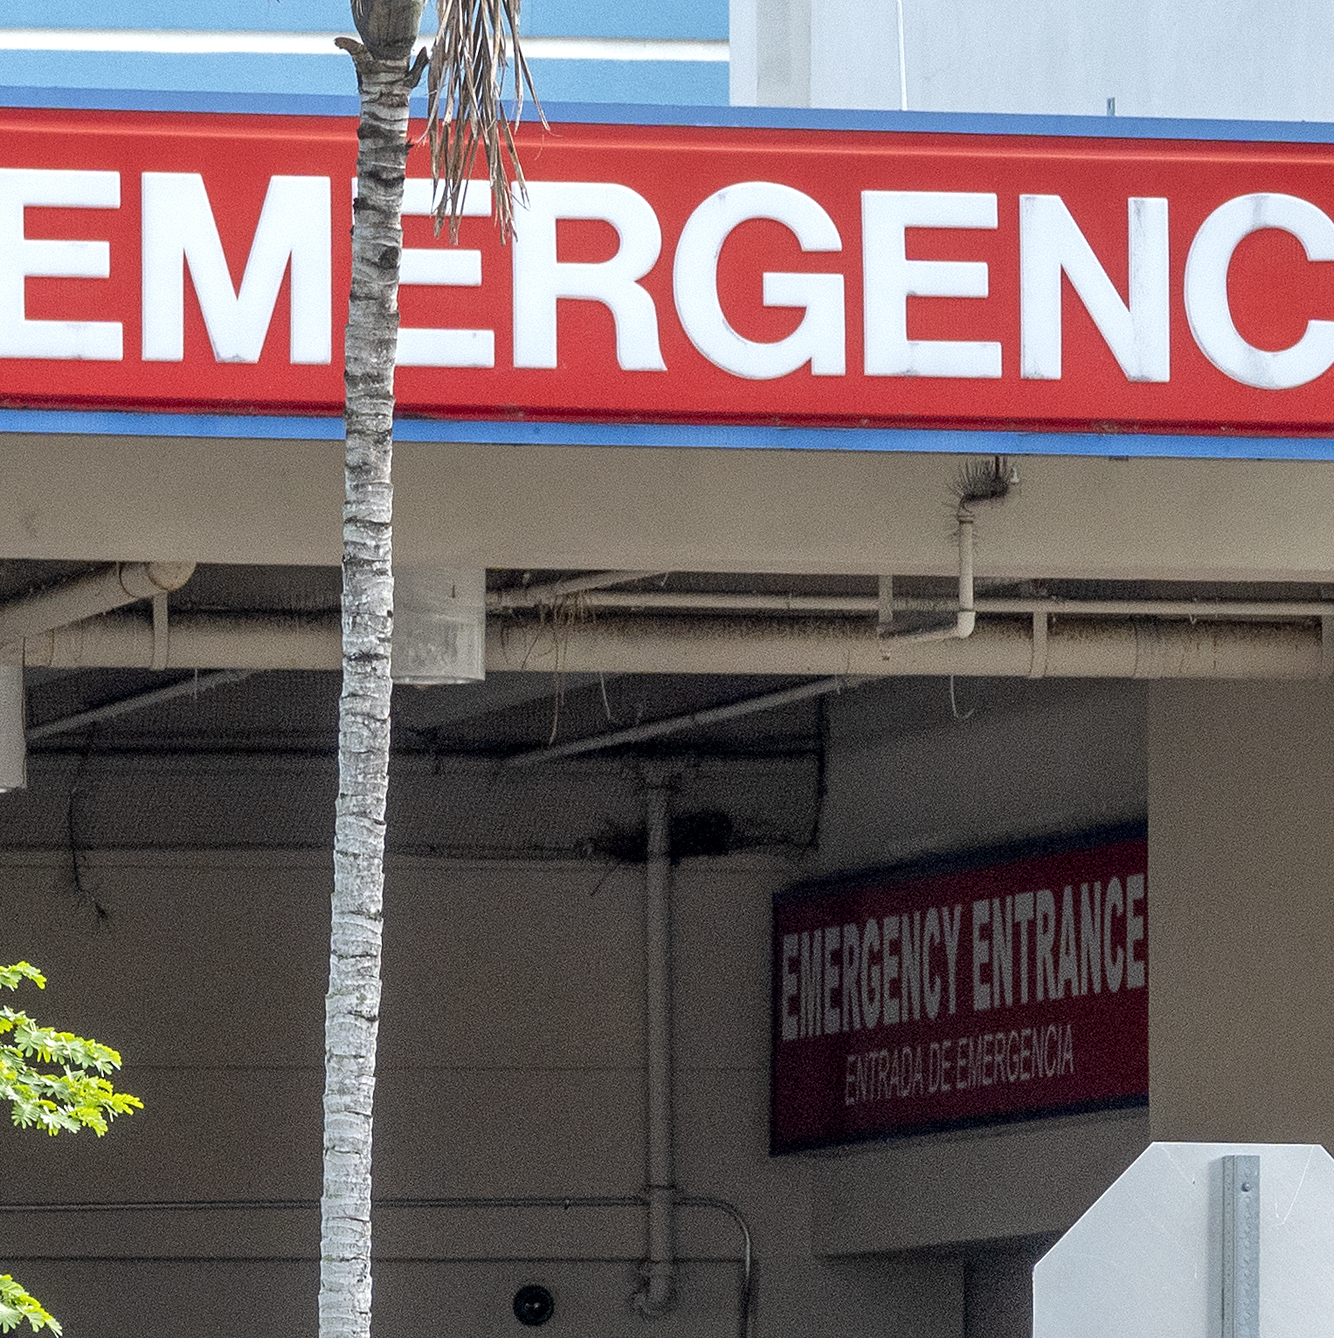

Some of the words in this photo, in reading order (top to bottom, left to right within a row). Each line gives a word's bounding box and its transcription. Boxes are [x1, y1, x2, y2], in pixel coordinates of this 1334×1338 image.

[781, 905, 963, 1042] EMERGENCY
[972, 873, 1146, 1012] ENTRANCE
[844, 1044, 923, 1106] ENTRADA
[928, 1040, 955, 1094] DE
[956, 1023, 1075, 1091] EMERGENCIA
